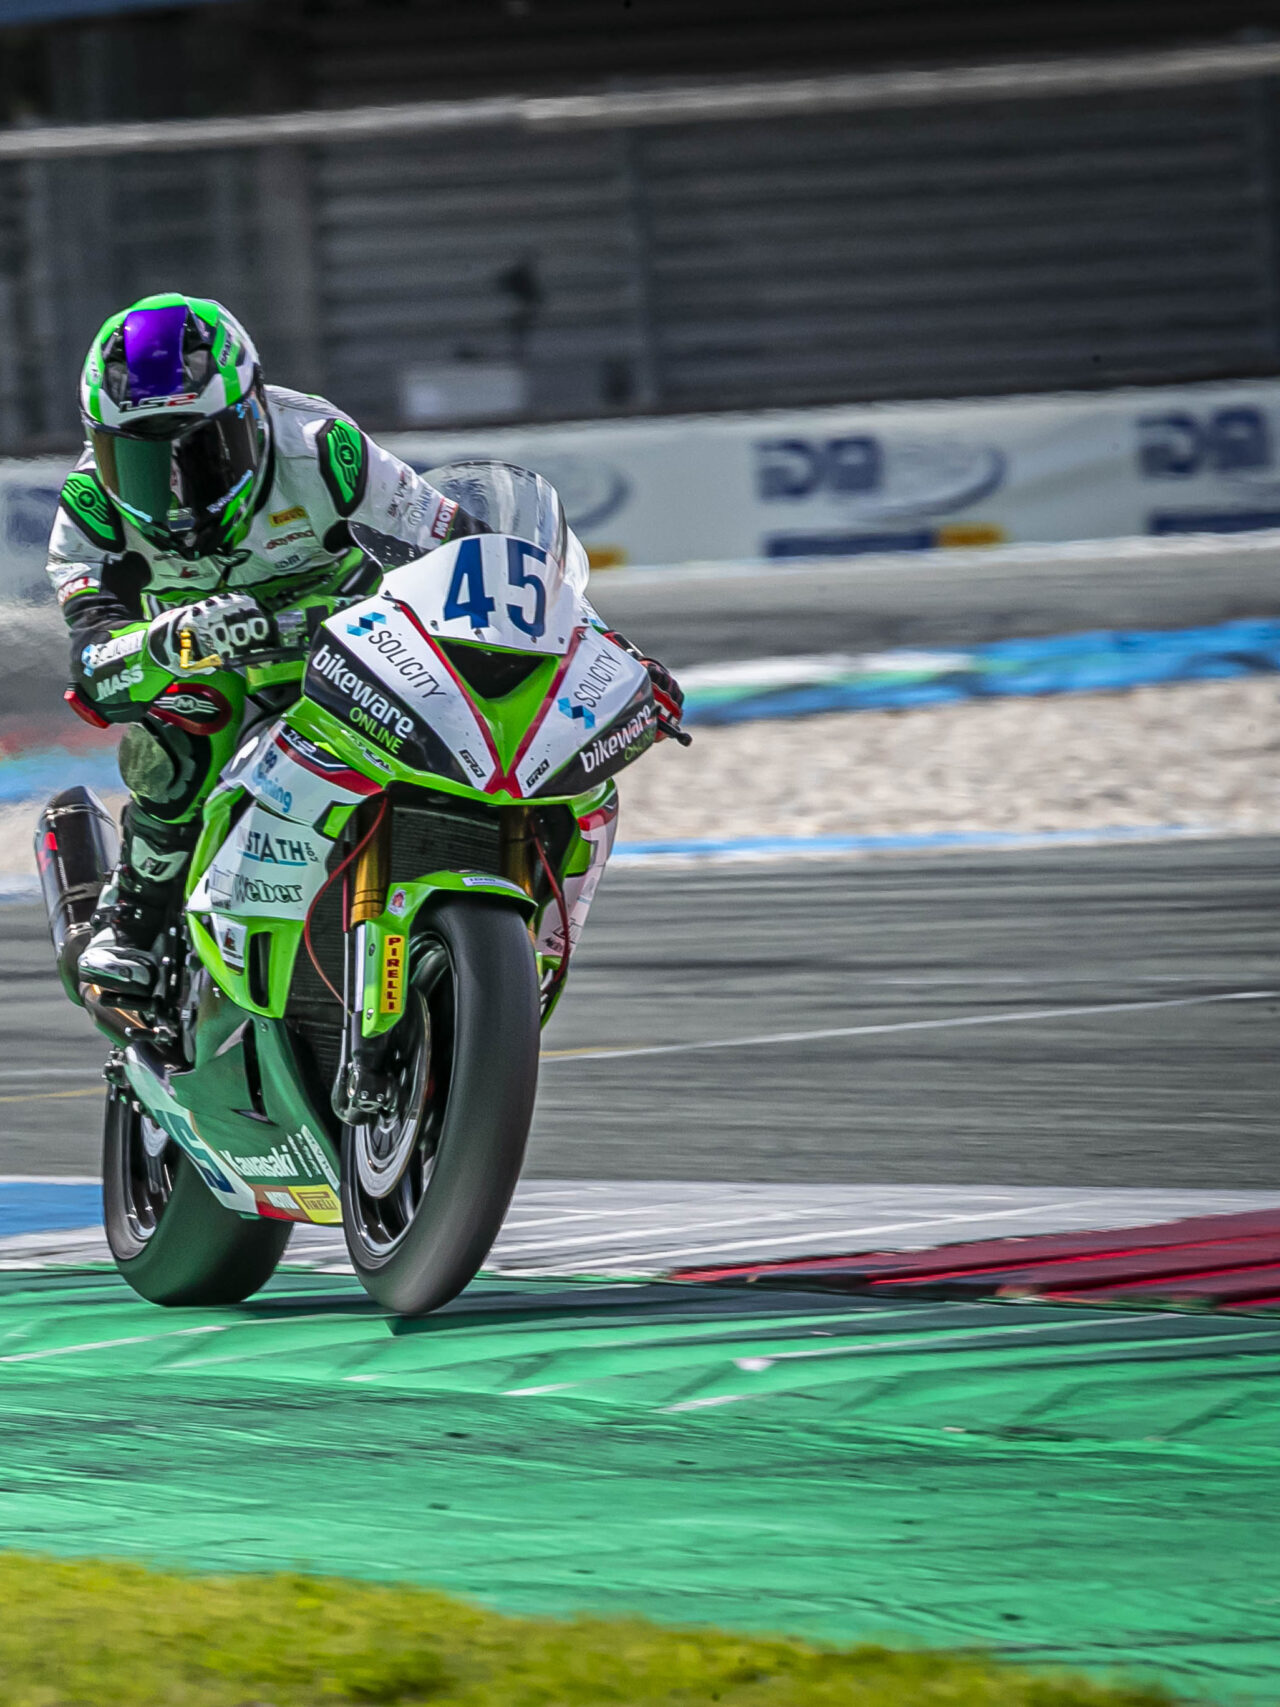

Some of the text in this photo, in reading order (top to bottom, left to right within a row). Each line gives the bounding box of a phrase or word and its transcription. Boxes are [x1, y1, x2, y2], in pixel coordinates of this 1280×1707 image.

[119, 392, 198, 413] LS2
[443, 538, 547, 637] 45
[311, 644, 415, 739] bikeware
[368, 630, 447, 699] SOLICITY
[574, 649, 622, 708] SOLICITY
[349, 706, 404, 755] ONLINE
[579, 704, 652, 773] bikeware
[234, 873, 303, 904] Weber
[386, 937, 402, 1011] PIRELLI
[219, 1144, 300, 1178] Kawasaki
[296, 1190, 339, 1211] PIRELLI
